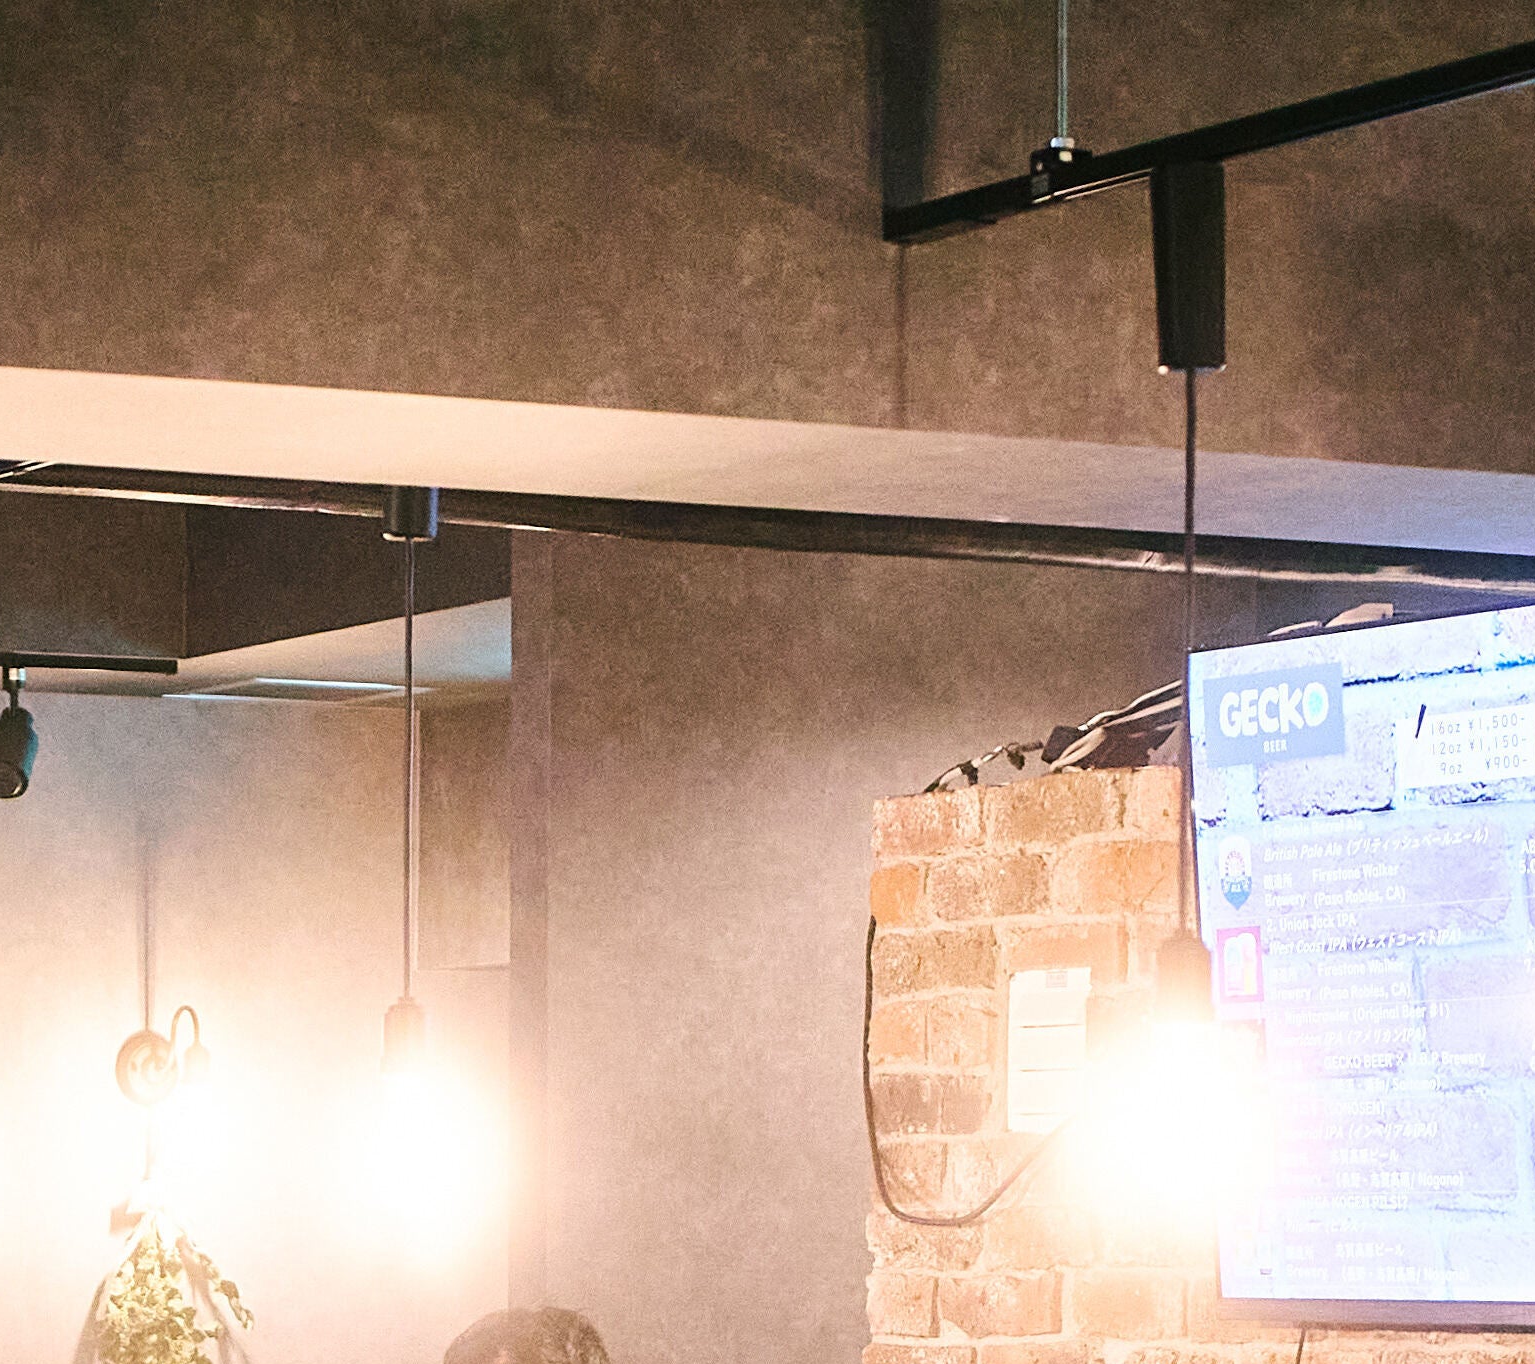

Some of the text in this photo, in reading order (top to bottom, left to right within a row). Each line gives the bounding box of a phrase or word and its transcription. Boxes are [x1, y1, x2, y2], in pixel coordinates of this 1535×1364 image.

[1219, 682, 1329, 738] GECKO
[1430, 720, 1461, 735] 16oz
[1263, 740, 1287, 755] BEER
[1432, 741, 1462, 756] 12oz
[1439, 760, 1462, 775] 9oz
[1264, 847, 1297, 862] British
[1300, 845, 1322, 859] Pale
[1325, 843, 1342, 856] Ale
[1312, 864, 1399, 883] Firestone Walker
[1264, 893, 1306, 907] Brewery
[1385, 885, 1406, 903] CA)
[1279, 916, 1310, 931] Union
[1337, 913, 1357, 927] IPA
[1317, 962, 1365, 976] Firestone
[1390, 980, 1412, 996] CA)
[1352, 1005, 1399, 1024] (Original
[1402, 1003, 1426, 1021] Beer
[1325, 1028, 1343, 1045] IPA
[1324, 1055, 1361, 1069] GECKO
[1364, 1054, 1392, 1068] BEER
